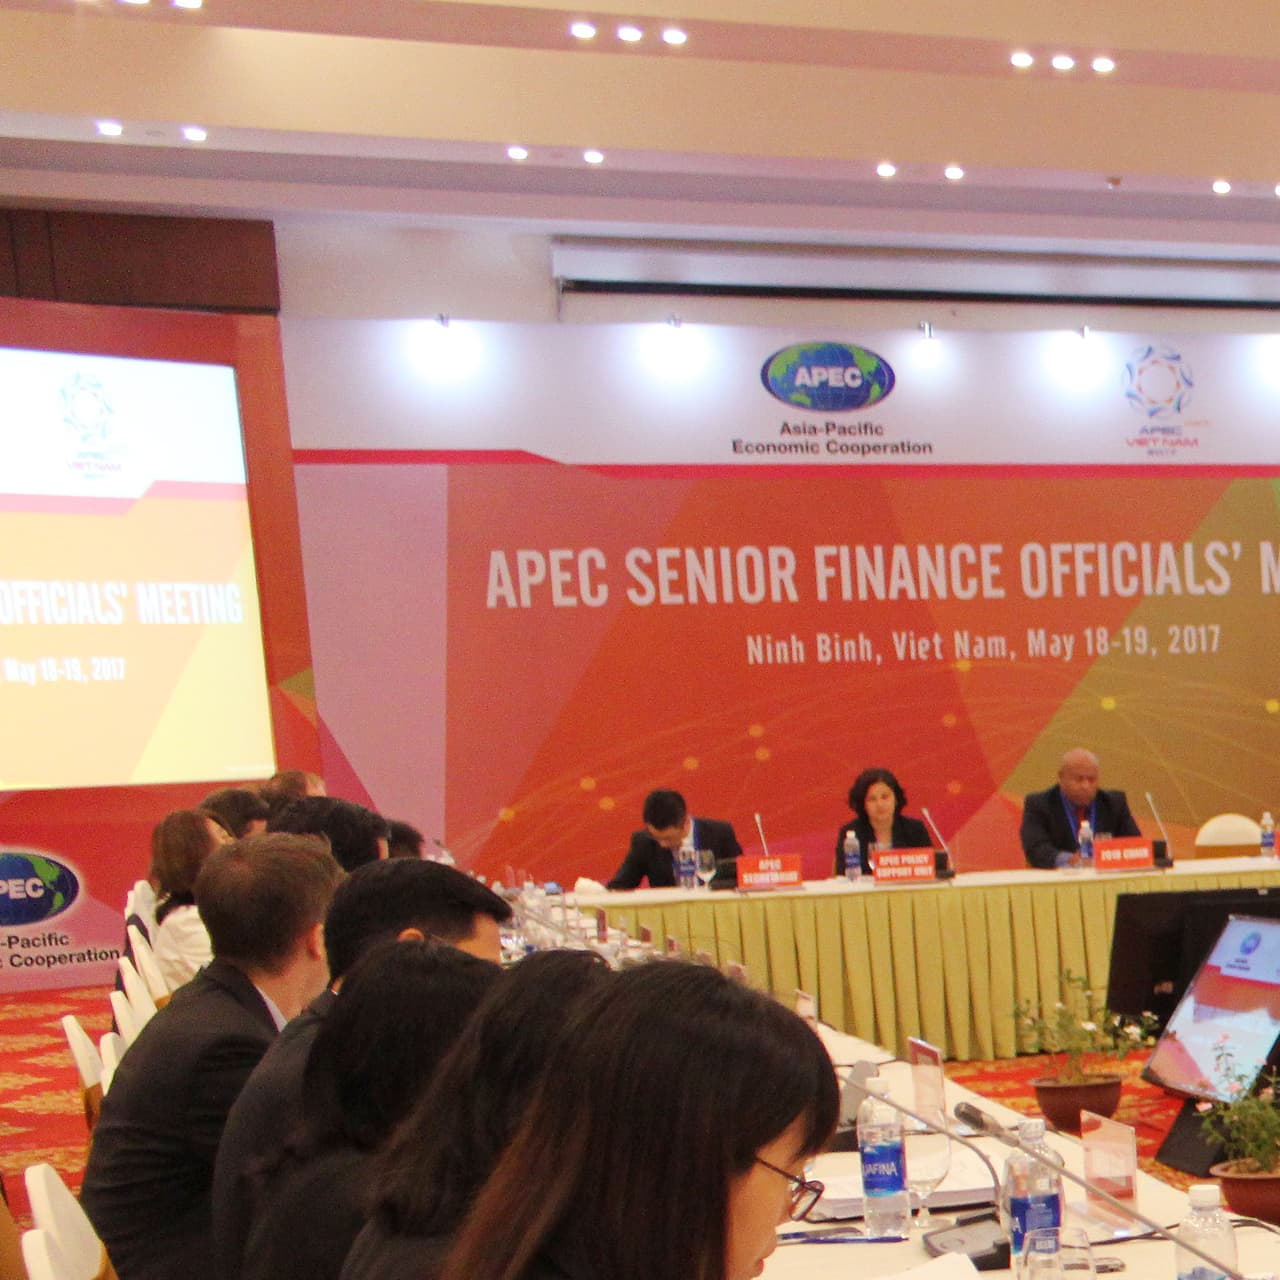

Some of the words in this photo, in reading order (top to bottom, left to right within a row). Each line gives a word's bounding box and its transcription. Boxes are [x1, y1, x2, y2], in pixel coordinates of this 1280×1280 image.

[794, 367, 864, 388] APEC
[780, 422, 884, 437] Asia-Pacific
[732, 440, 820, 455] Economic
[826, 440, 933, 457] Cooperation
[486, 549, 608, 609] APEC
[625, 545, 799, 607] SENIOR
[814, 543, 1006, 602] FINANCE
[1020, 541, 1242, 599] OFFICIALS'
[135, 581, 244, 625] MEETING
[746, 634, 805, 664] Ninh
[817, 633, 883, 666] Binh,
[893, 630, 944, 661] Viet
[954, 630, 1017, 661] Nam,
[1027, 628, 1075, 662] May
[1083, 626, 1157, 658] 18-19,
[1168, 625, 1221, 655] 2017
[3, 658, 36, 686] May
[91, 657, 126, 680] 2017
[0, 877, 45, 899] PEC
[0, 932, 70, 949] -Pacific
[10, 948, 120, 968] Cooperation
[863, 1161, 898, 1177] UAFINA
